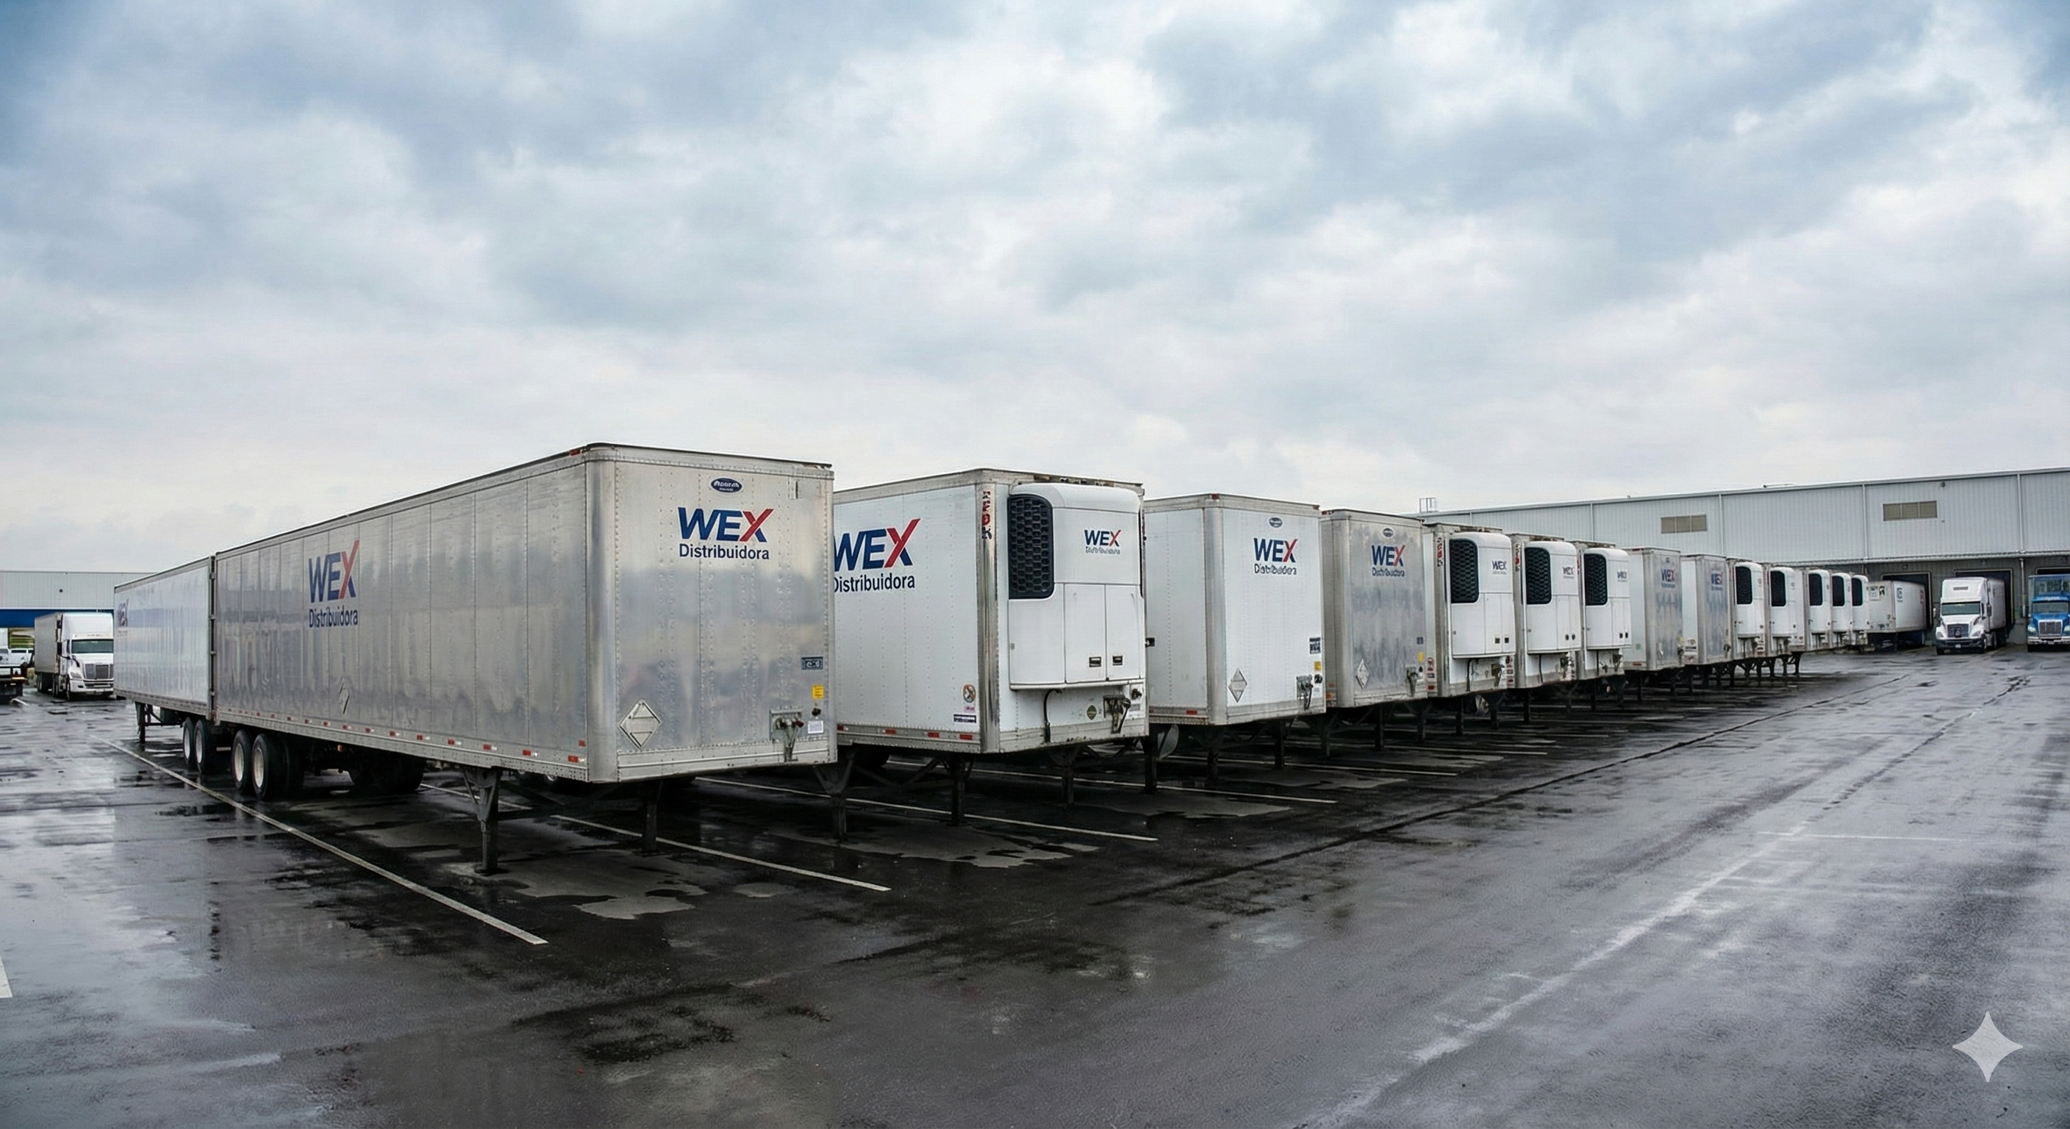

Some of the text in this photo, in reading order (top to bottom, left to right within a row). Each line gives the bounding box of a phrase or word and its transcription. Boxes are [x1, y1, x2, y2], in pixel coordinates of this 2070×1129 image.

[678, 507, 775, 543] WEX
[834, 518, 921, 572] WEX
[1084, 529, 1121, 547] WEX
[1253, 537, 1298, 563] WEX
[679, 543, 770, 560] Distribuidora
[1371, 544, 1406, 567] WEX
[308, 540, 360, 603] WEX
[309, 605, 359, 628] Distribuidora
